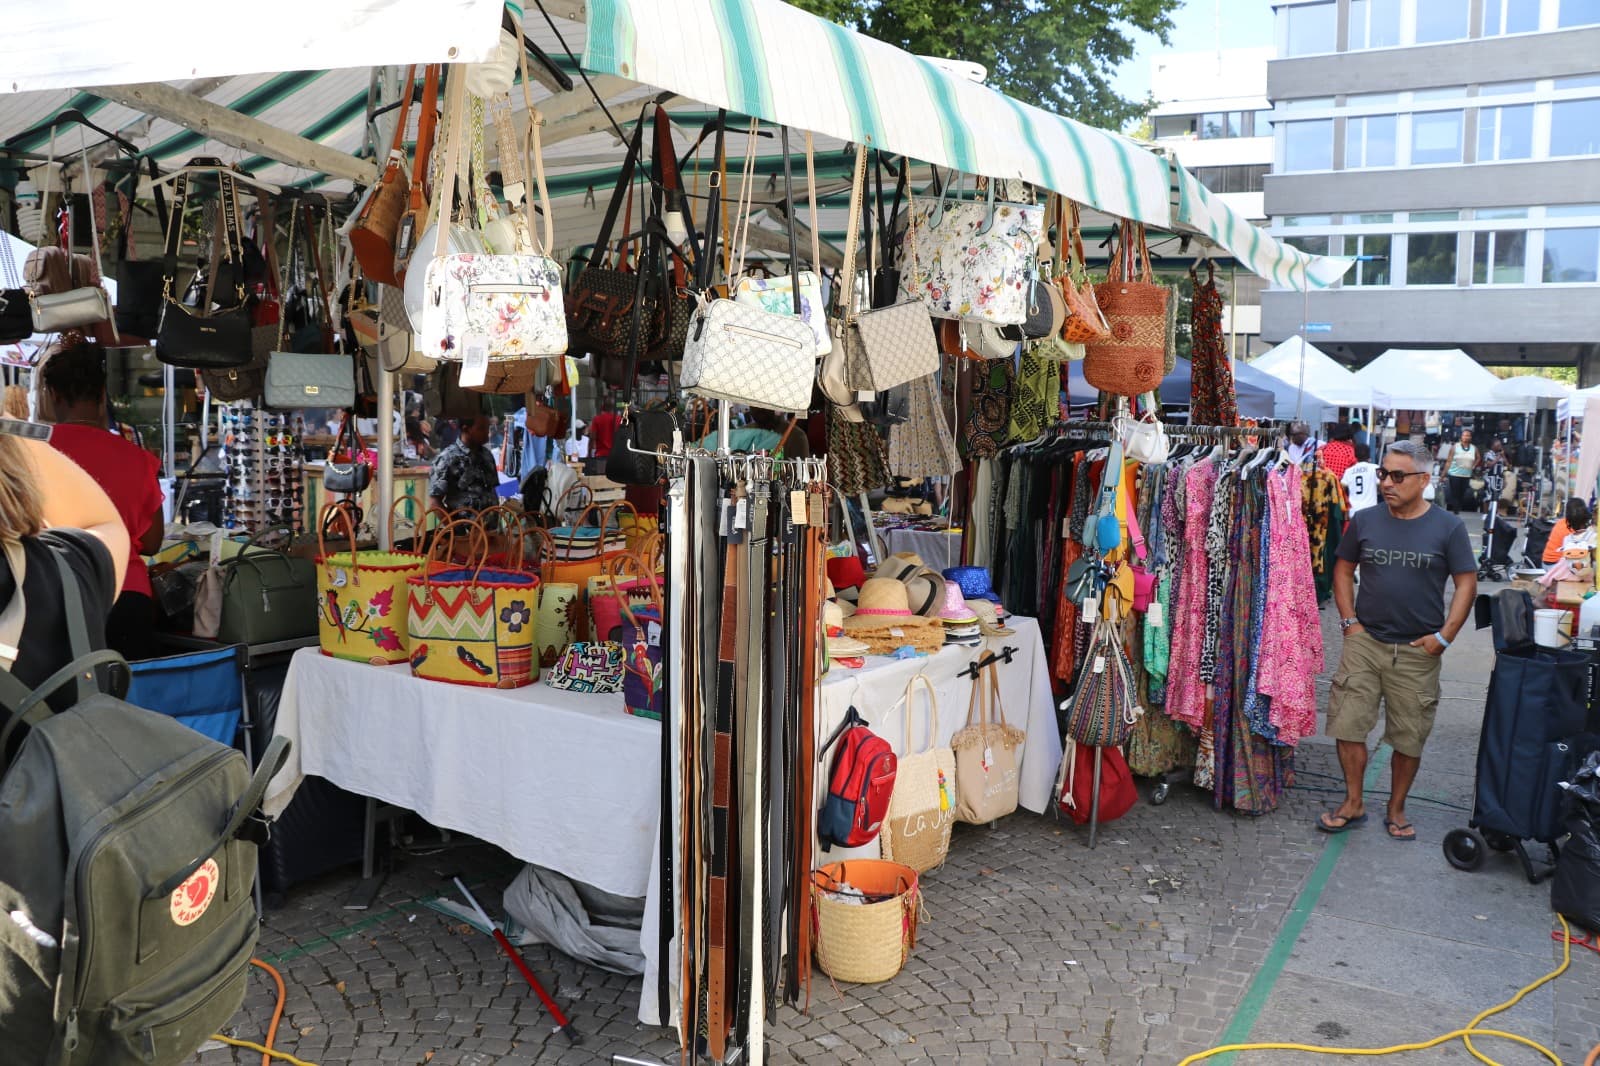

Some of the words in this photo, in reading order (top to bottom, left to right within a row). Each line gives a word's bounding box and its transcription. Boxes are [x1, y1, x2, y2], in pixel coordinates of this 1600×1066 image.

[225, 200, 236, 232] SWEET
[1355, 475, 1364, 495] 9
[1362, 547, 1436, 569] ESPRIT
